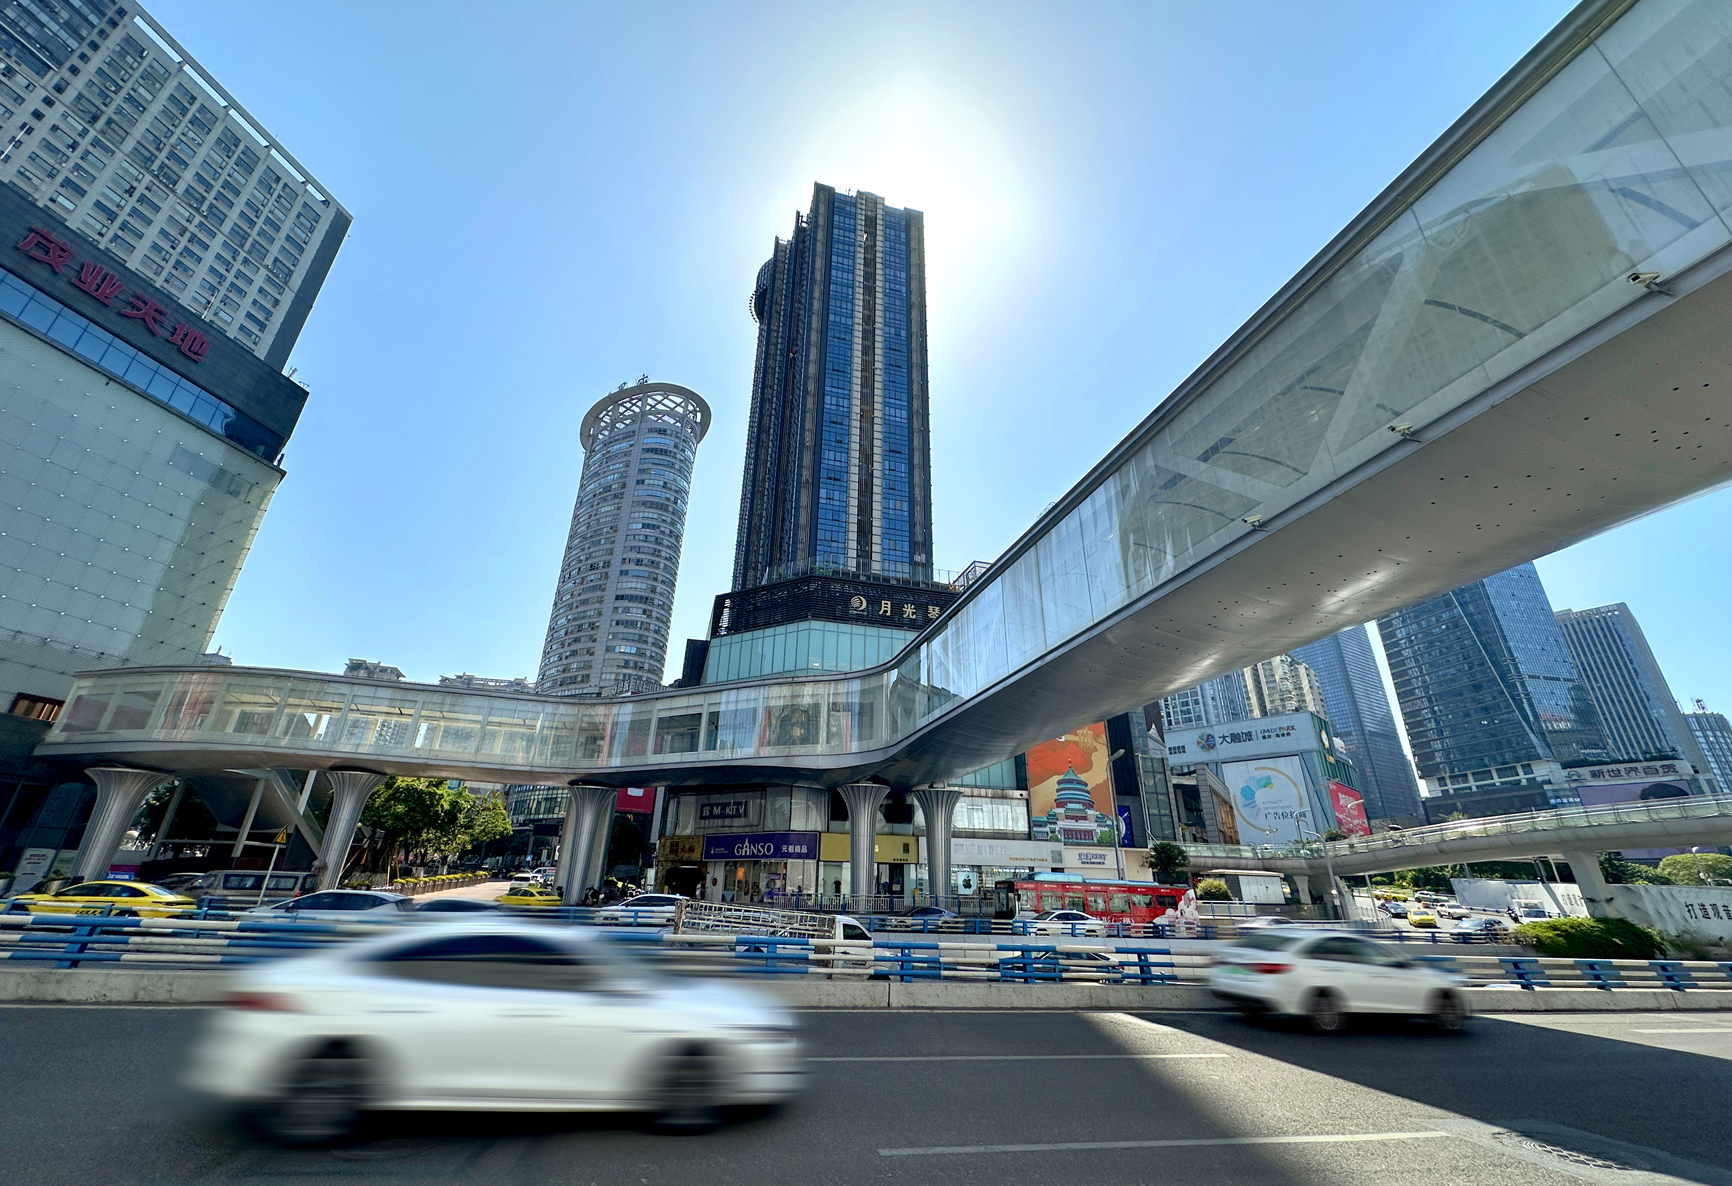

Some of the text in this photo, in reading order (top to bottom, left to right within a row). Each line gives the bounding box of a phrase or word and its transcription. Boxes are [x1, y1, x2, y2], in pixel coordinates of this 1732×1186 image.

[17, 224, 212, 363] 茂业天地
[878, 599, 941, 619] 月光琴
[1218, 730, 1254, 745] 大融城
[1588, 763, 1680, 779] 新世界百货
[734, 837, 774, 856] GANSO
[1684, 901, 1732, 920] 打造观音
